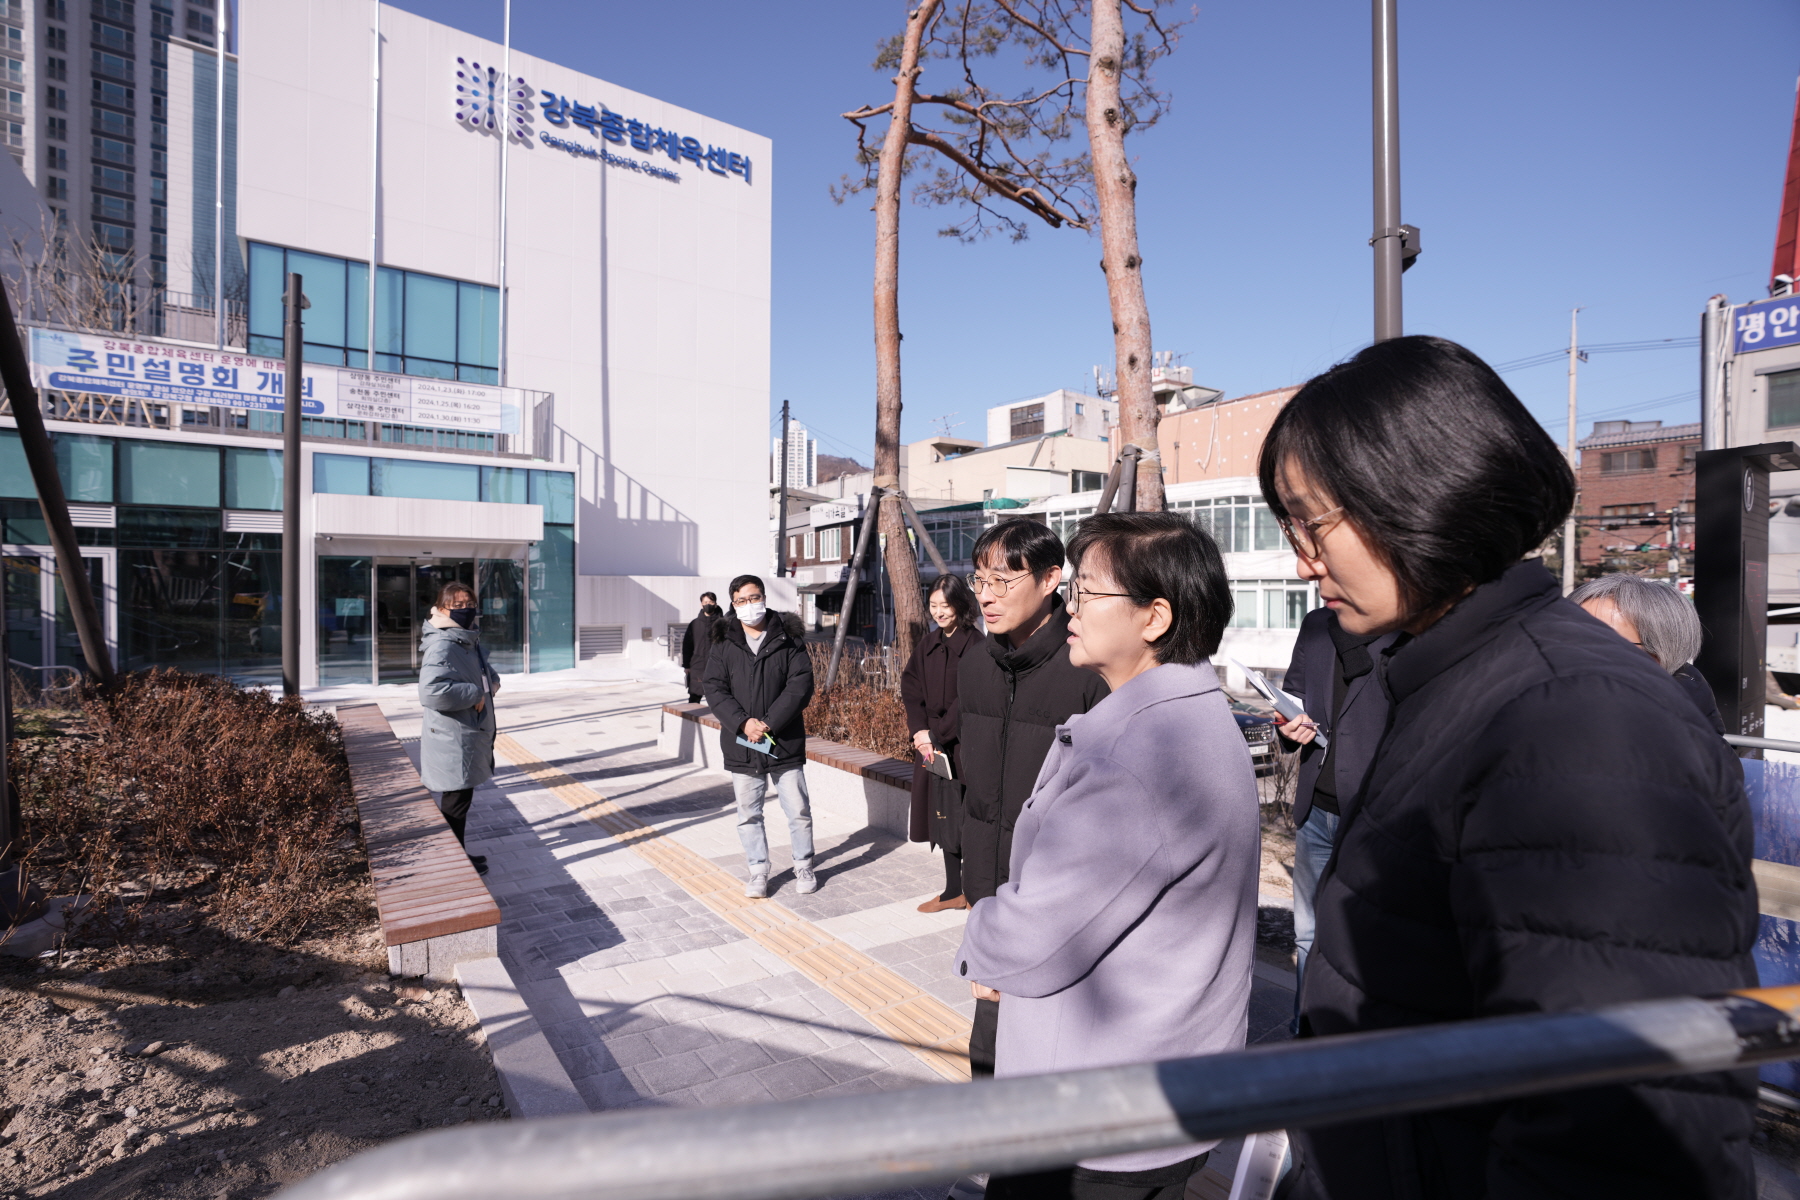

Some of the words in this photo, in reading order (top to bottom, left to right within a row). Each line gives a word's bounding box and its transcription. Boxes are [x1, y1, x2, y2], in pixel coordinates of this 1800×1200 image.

[540, 89, 752, 182] 강북종합체육센터
[540, 131, 597, 157] Gangbuk
[600, 149, 638, 171] Sports
[642, 160, 679, 180] Center
[1737, 305, 1800, 343] 평안
[103, 340, 214, 363] 강북종합체육센터
[221, 355, 257, 368] 운영에
[66, 348, 238, 389] 주민설명회
[374, 375, 401, 385] 주민센터
[373, 390, 400, 399] 주민센터
[467, 389, 486, 397] 17:00
[377, 406, 404, 415] 주민센터
